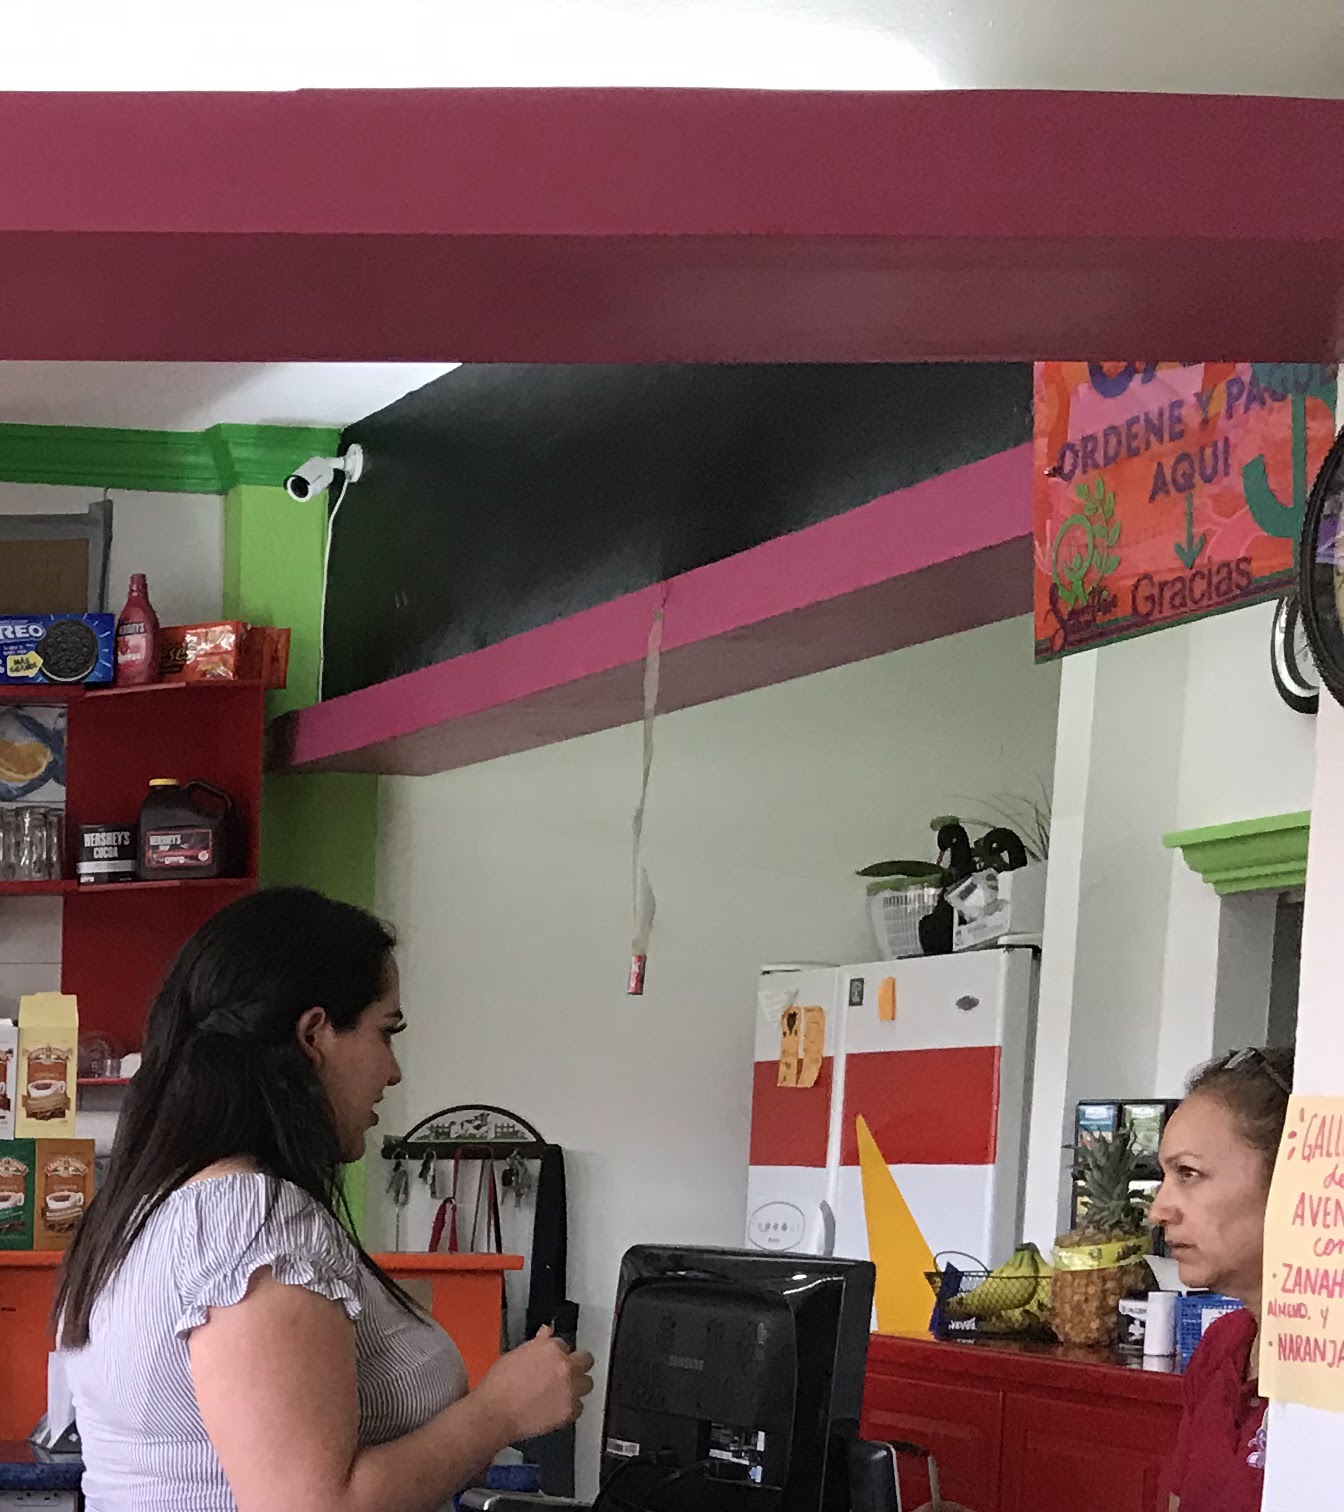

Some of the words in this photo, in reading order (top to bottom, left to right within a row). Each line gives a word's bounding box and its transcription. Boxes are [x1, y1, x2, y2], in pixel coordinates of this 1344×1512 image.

[1058, 400, 1185, 481] ORDENE
[1193, 384, 1216, 430] Y
[1148, 437, 1230, 503] AQUI
[1130, 555, 1254, 620] Gracias
[84, 832, 131, 847] HERSHEY'S
[93, 847, 119, 859] COCOA
